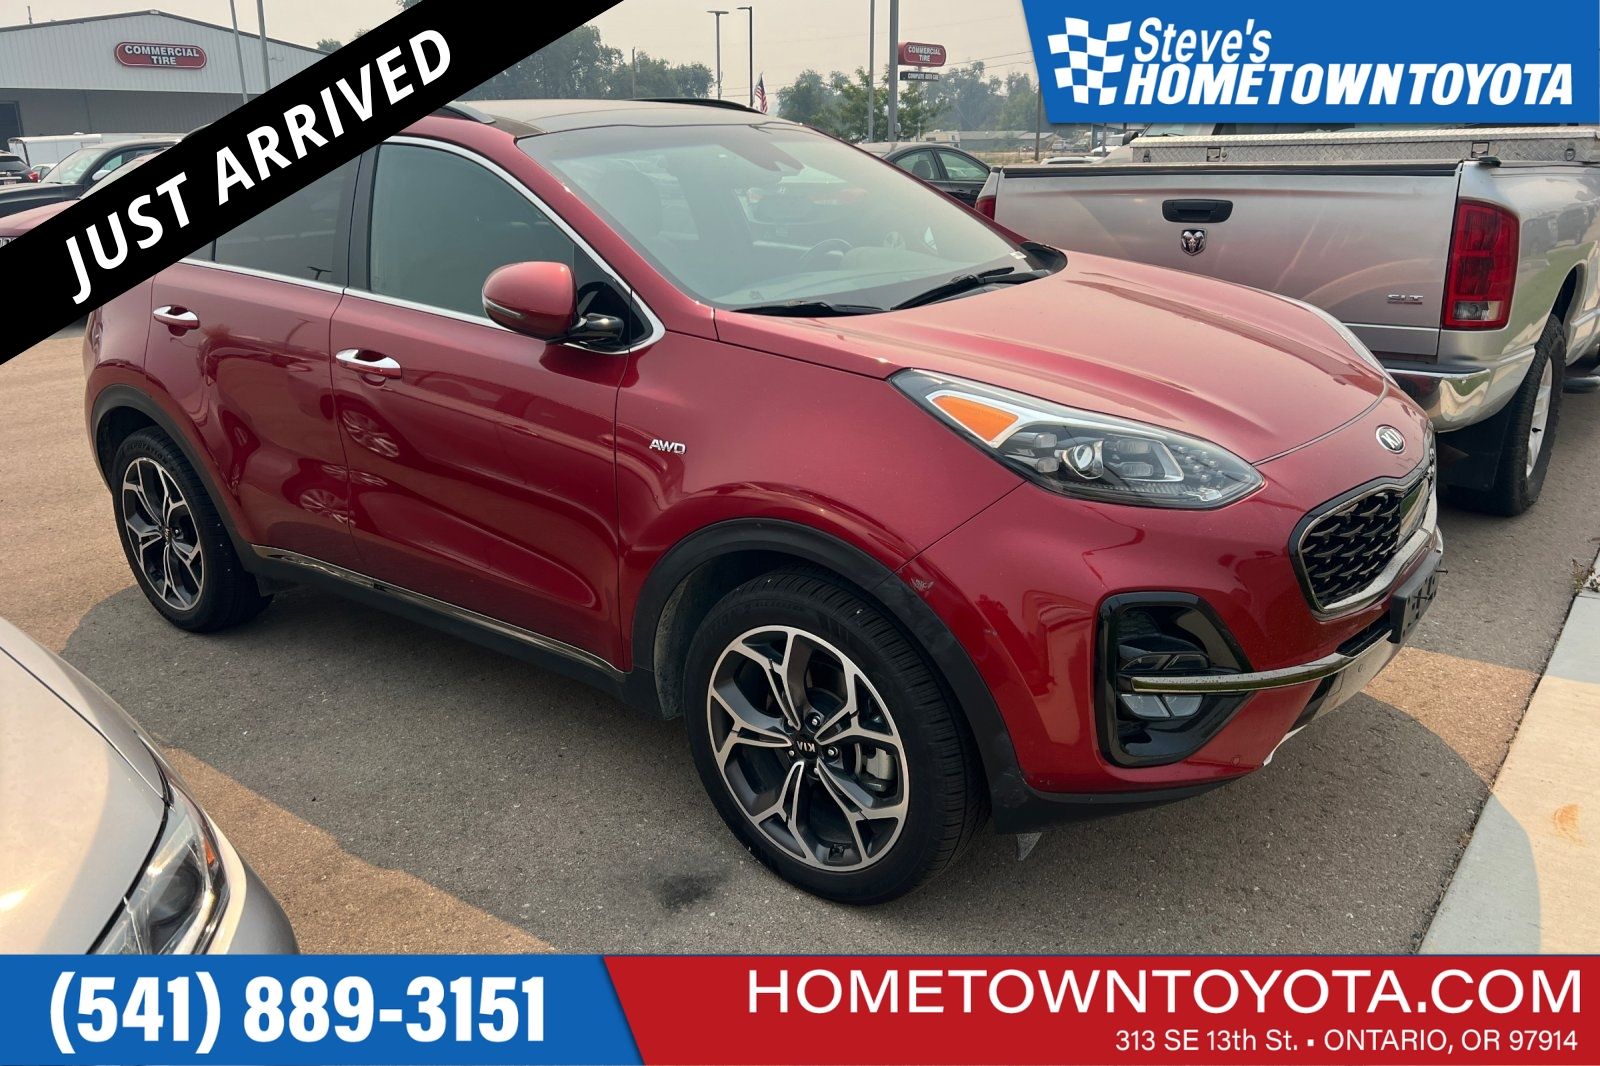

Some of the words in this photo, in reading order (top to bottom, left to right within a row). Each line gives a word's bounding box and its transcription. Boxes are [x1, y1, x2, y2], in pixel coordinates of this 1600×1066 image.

[125, 45, 200, 57] COMMERCIAL
[908, 46, 941, 55] COMMERCIAL
[151, 56, 176, 65] TIRE
[919, 54, 930, 62] TIRE
[649, 439, 686, 454] AWD
